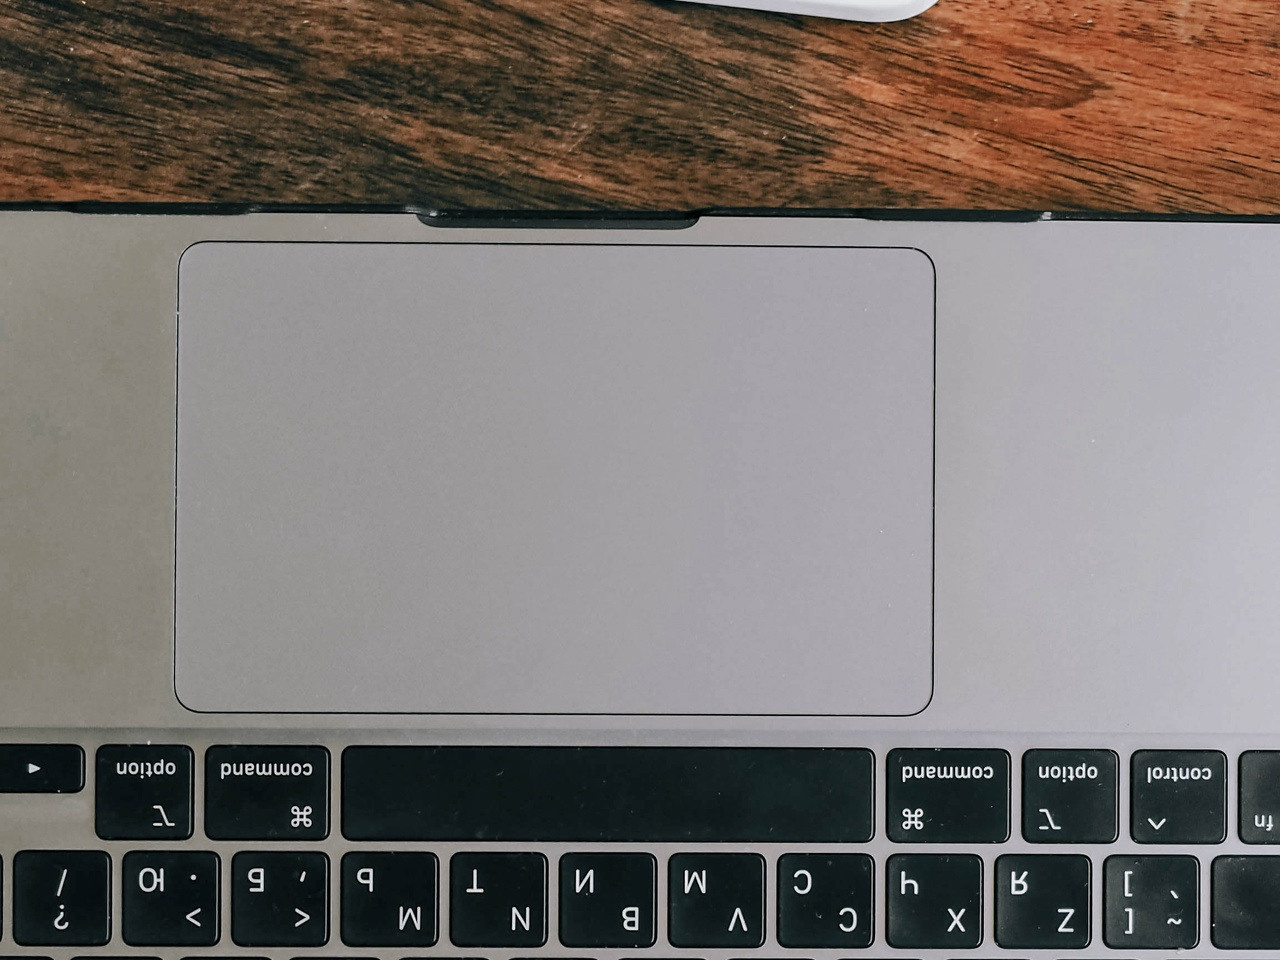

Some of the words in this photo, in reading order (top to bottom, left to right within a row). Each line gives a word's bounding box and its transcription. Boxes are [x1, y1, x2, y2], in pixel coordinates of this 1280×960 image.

[116, 758, 176, 778] option
[220, 762, 313, 780] command
[902, 765, 994, 783] command
[1038, 762, 1099, 783] option
[1147, 766, 1212, 784] control
[1254, 814, 1274, 832] fn
[399, 905, 421, 931] M
[511, 906, 530, 931] N
[621, 906, 640, 931] B
[728, 907, 748, 932] V
[838, 907, 858, 933] C
[946, 908, 966, 933] X
[1057, 908, 1075, 933] Z
